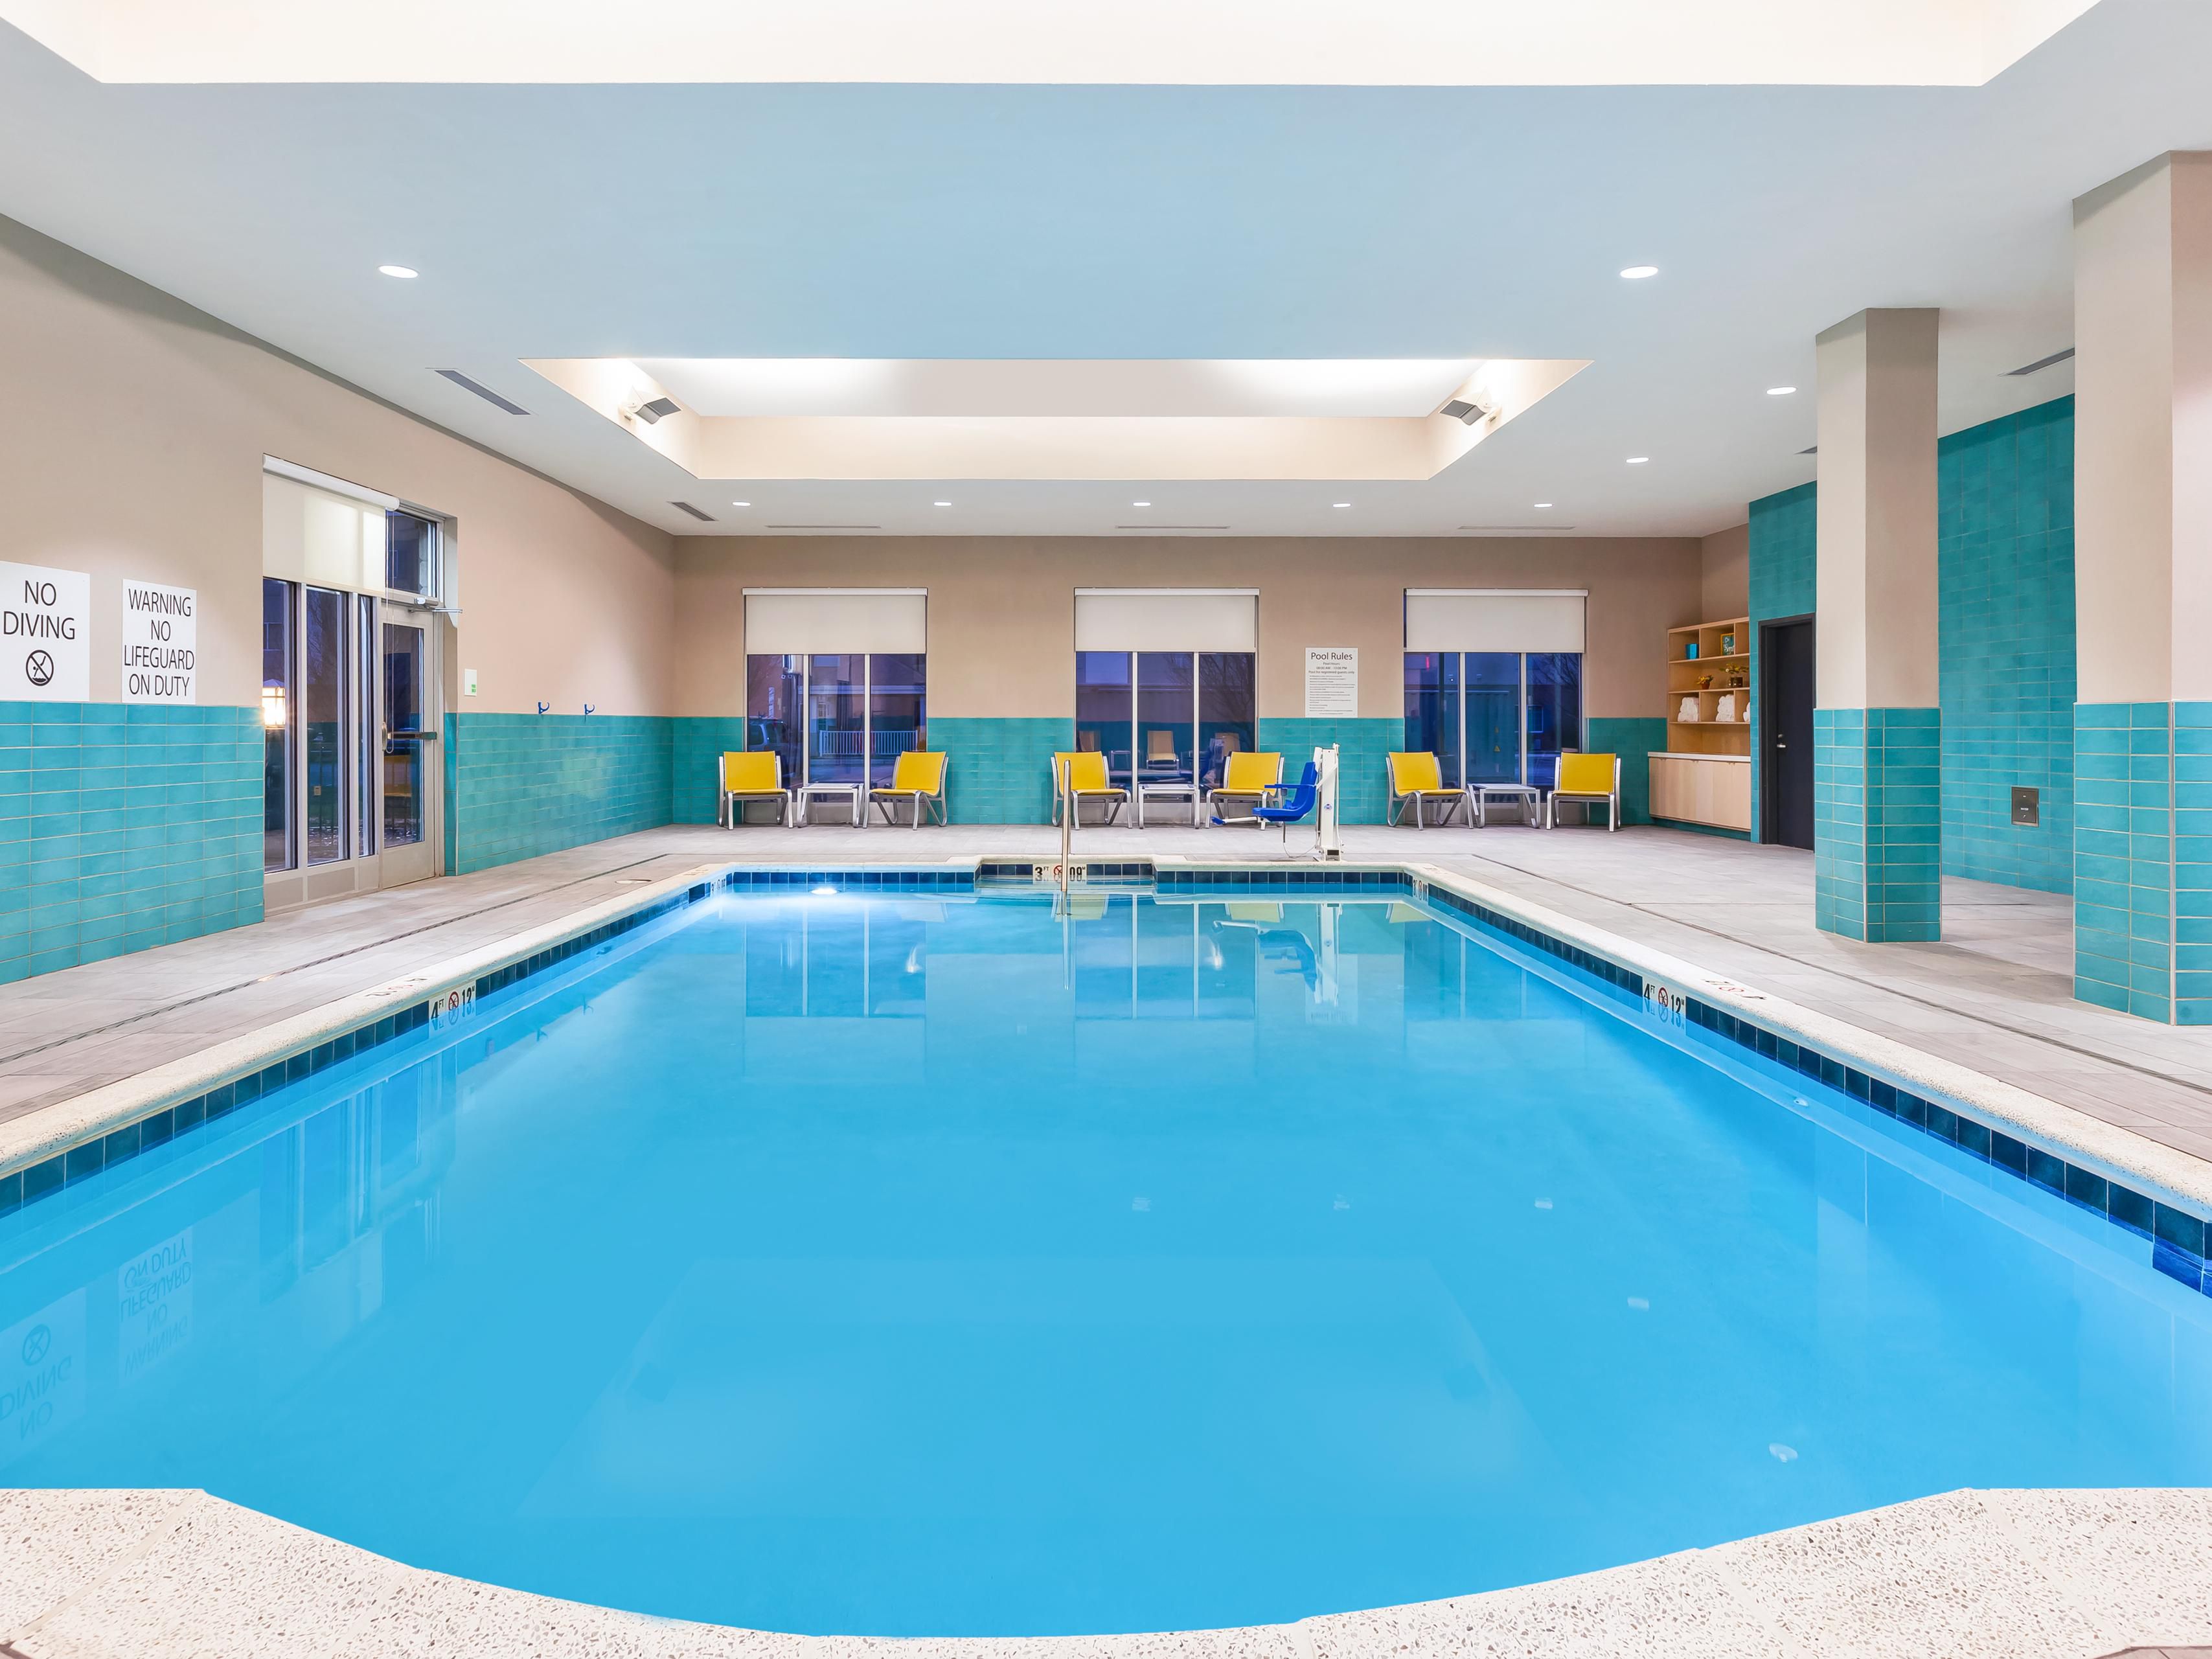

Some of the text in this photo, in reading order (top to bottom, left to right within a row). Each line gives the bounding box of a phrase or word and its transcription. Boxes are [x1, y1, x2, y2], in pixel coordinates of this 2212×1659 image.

[25, 580, 56, 606] NO
[128, 588, 191, 617] WARNING
[3, 611, 75, 639] DIVING
[151, 619, 171, 641] NO
[124, 645, 194, 670] LIFEGUARD
[129, 673, 190, 696] ON DUTY
